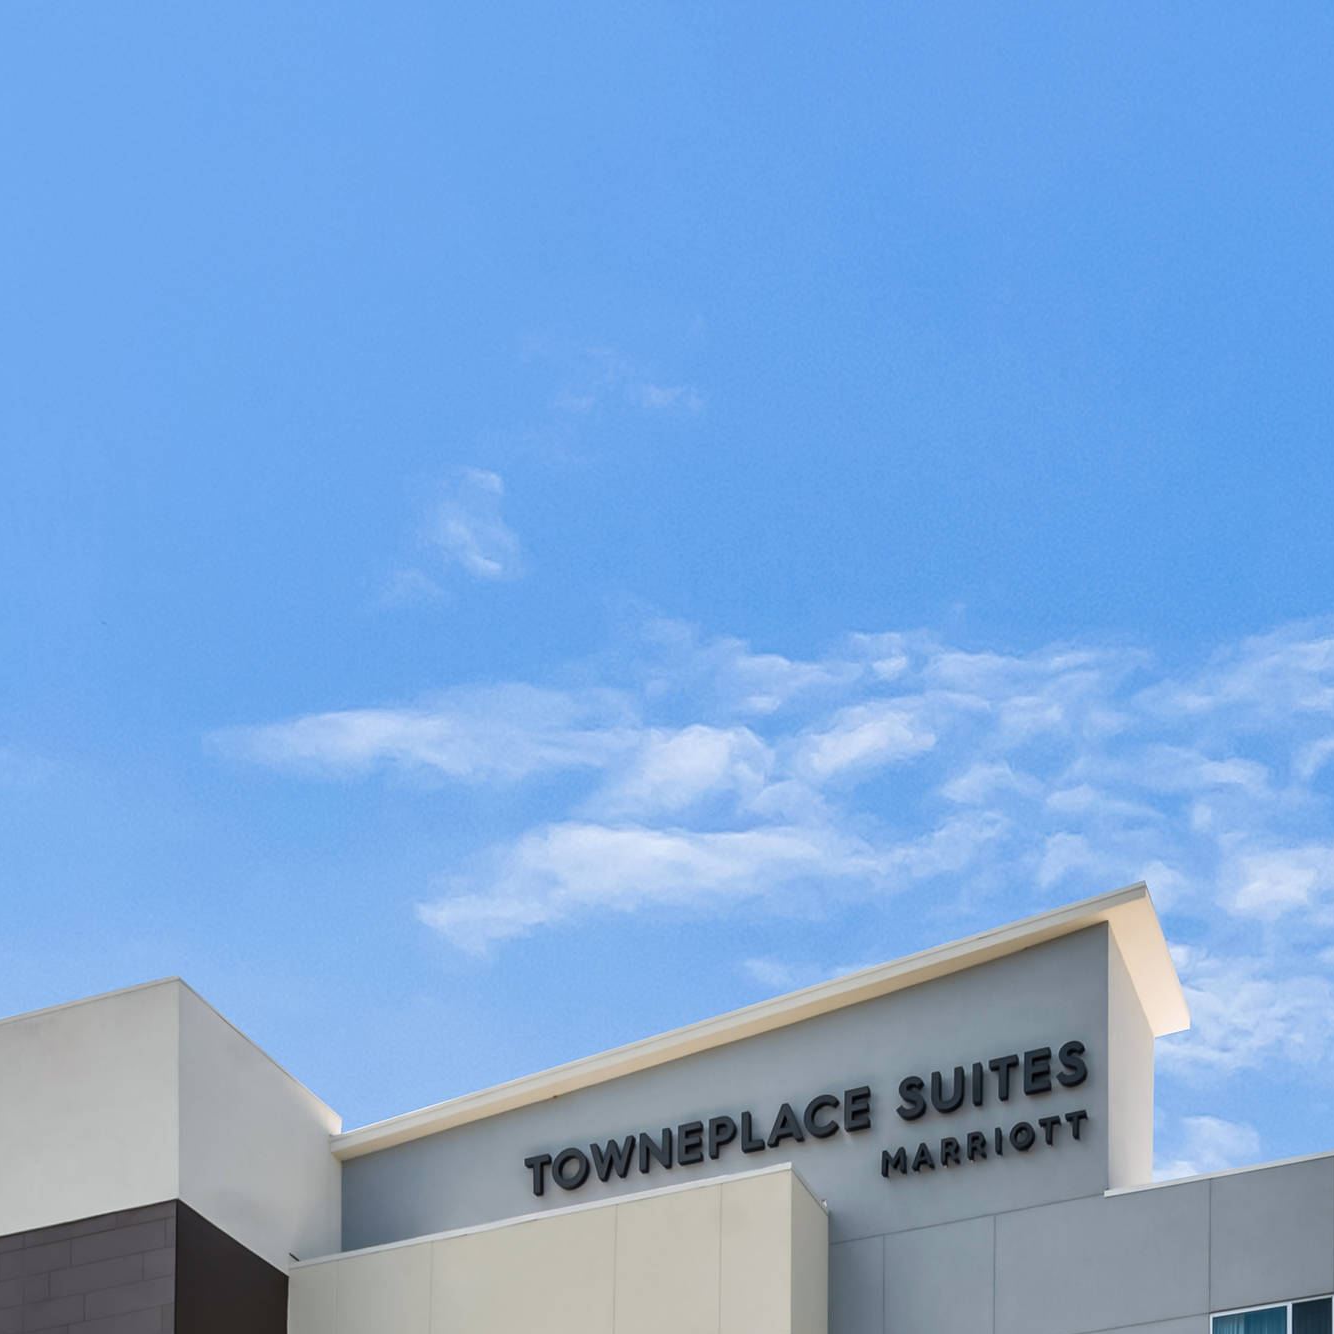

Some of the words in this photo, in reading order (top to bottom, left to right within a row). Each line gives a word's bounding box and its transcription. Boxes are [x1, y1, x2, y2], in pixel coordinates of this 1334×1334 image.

[525, 1086, 872, 1197] TOWNEPLACE
[896, 1040, 1089, 1123] SUITES
[881, 1109, 1089, 1178] MARRIOTT
